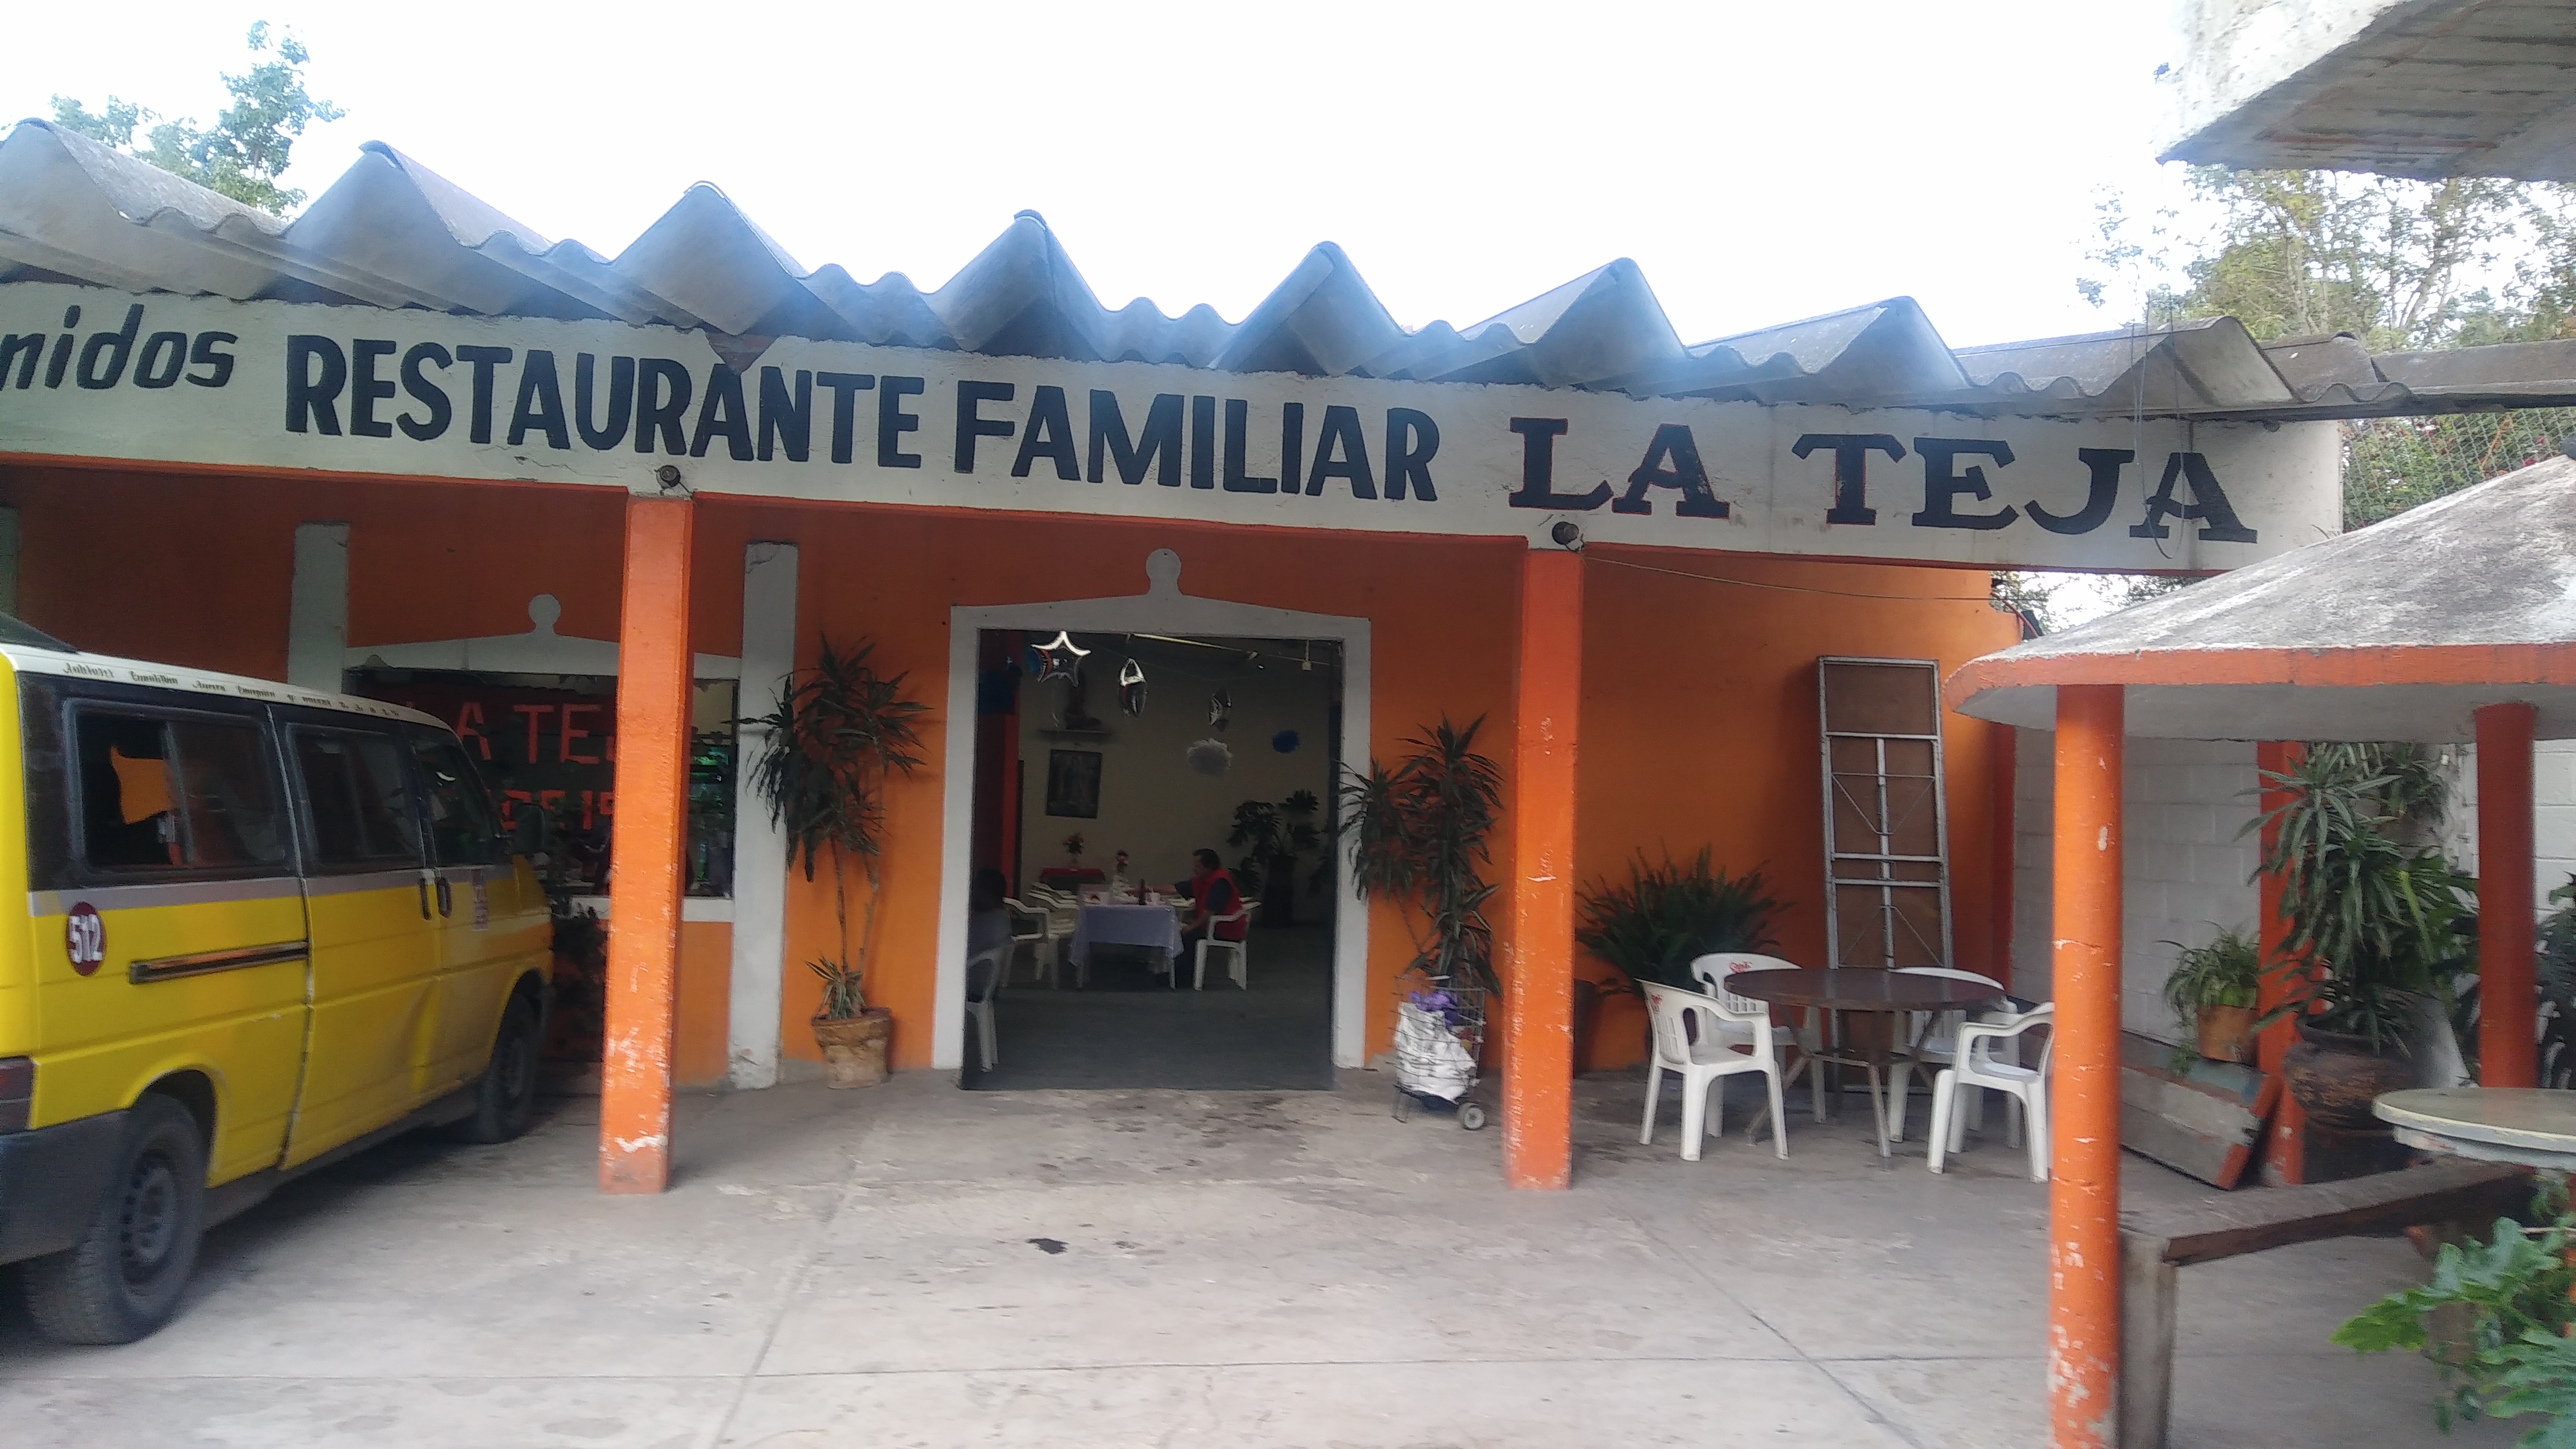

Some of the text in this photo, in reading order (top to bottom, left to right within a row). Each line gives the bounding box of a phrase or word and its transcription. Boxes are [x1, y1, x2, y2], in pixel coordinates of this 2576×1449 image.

[286, 334, 925, 468] RESTAURANTE
[954, 380, 1440, 502] FAMILIAR
[1509, 417, 1731, 520] LA
[1791, 433, 2257, 543] TEJA
[68, 913, 103, 963] 512
